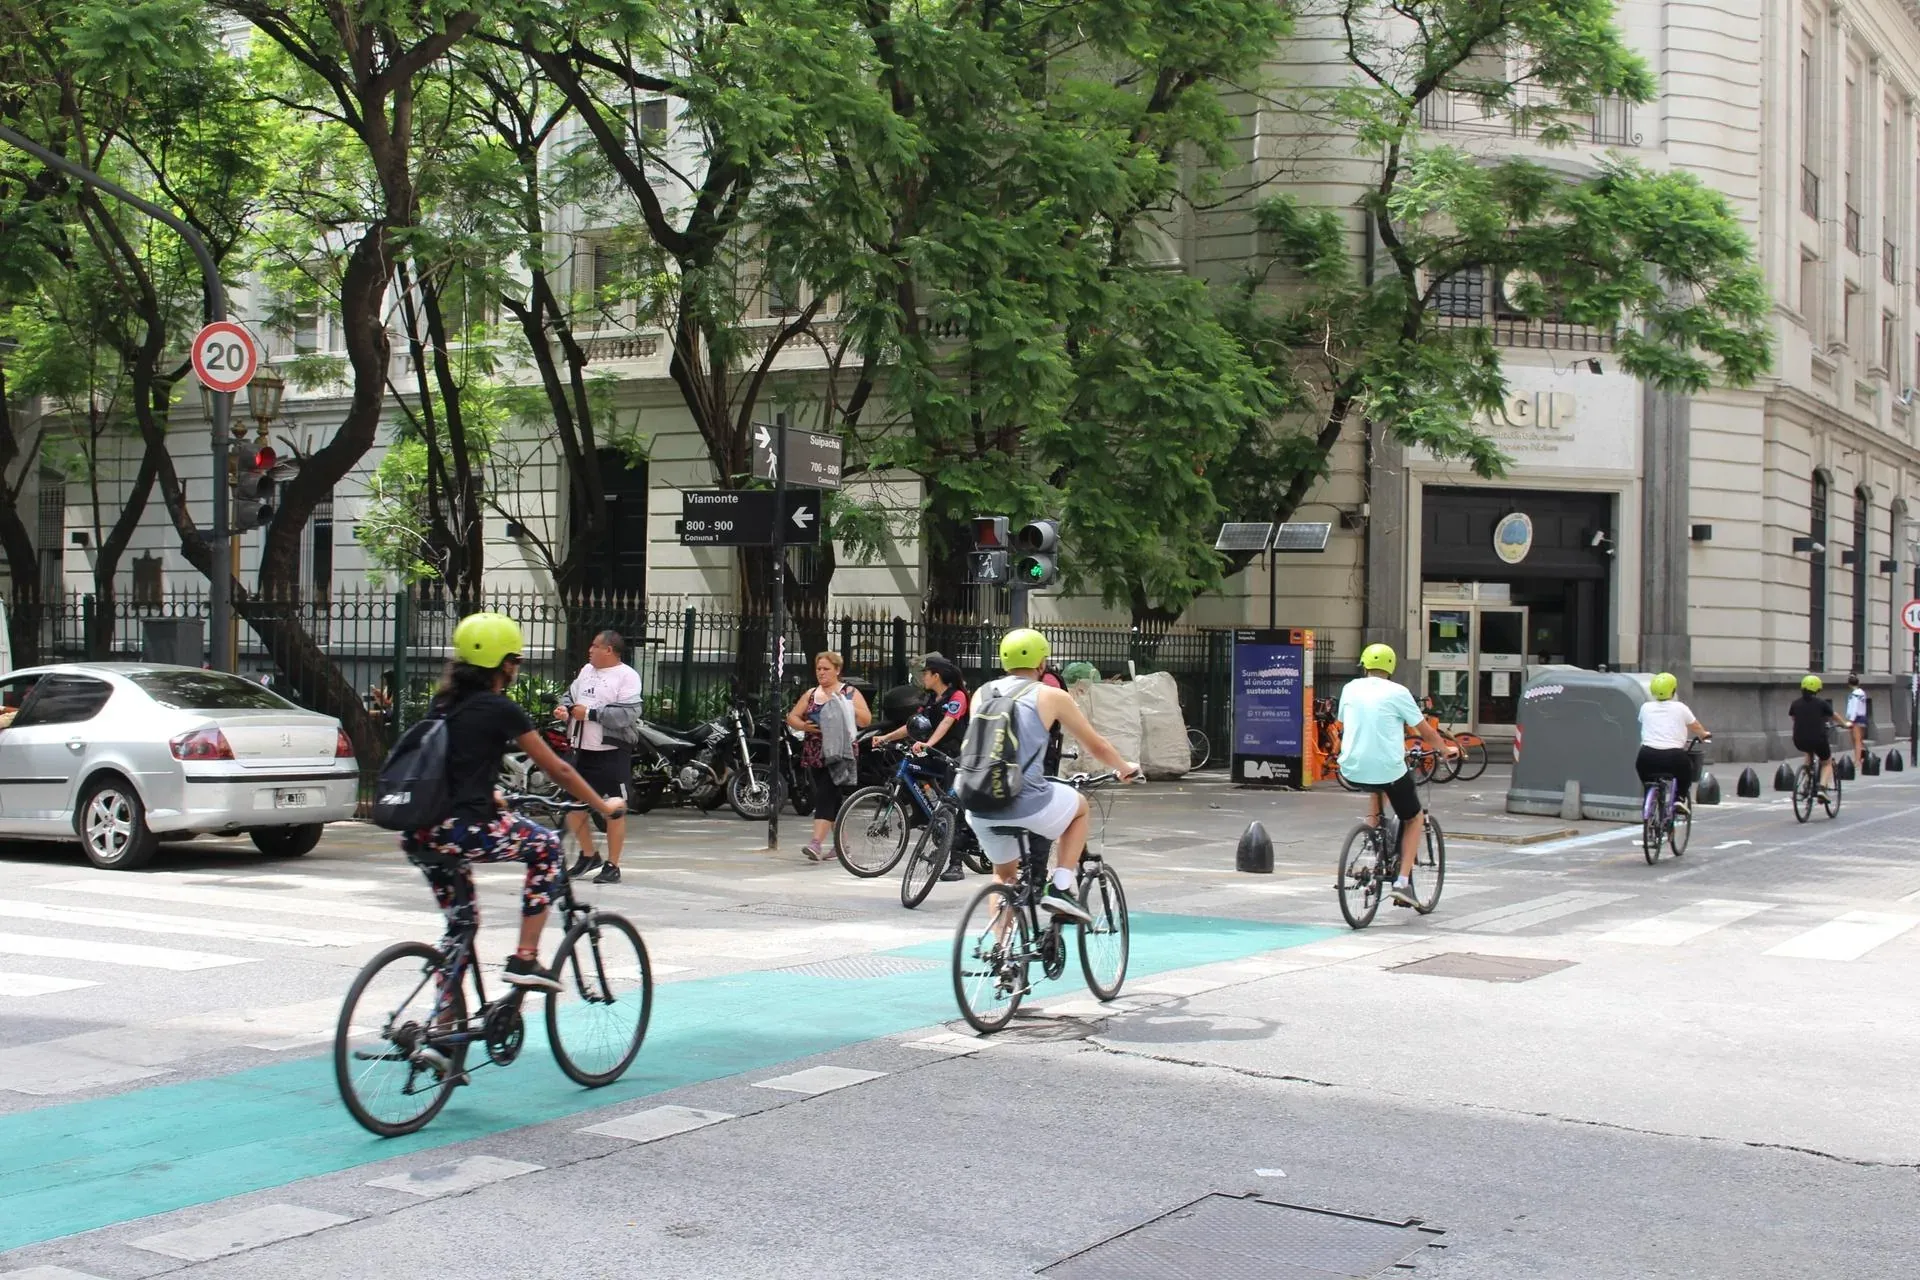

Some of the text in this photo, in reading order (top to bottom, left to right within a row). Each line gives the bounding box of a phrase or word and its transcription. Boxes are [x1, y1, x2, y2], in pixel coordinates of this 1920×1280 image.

[206, 342, 244, 372] 20
[810, 434, 840, 449] Suipacha
[810, 461, 823, 473] 700
[687, 493, 739, 504] Viamonte
[686, 520, 705, 531] 800
[714, 520, 734, 531] 900
[684, 533, 714, 541] Comuna
[1243, 760, 1274, 779] BA
